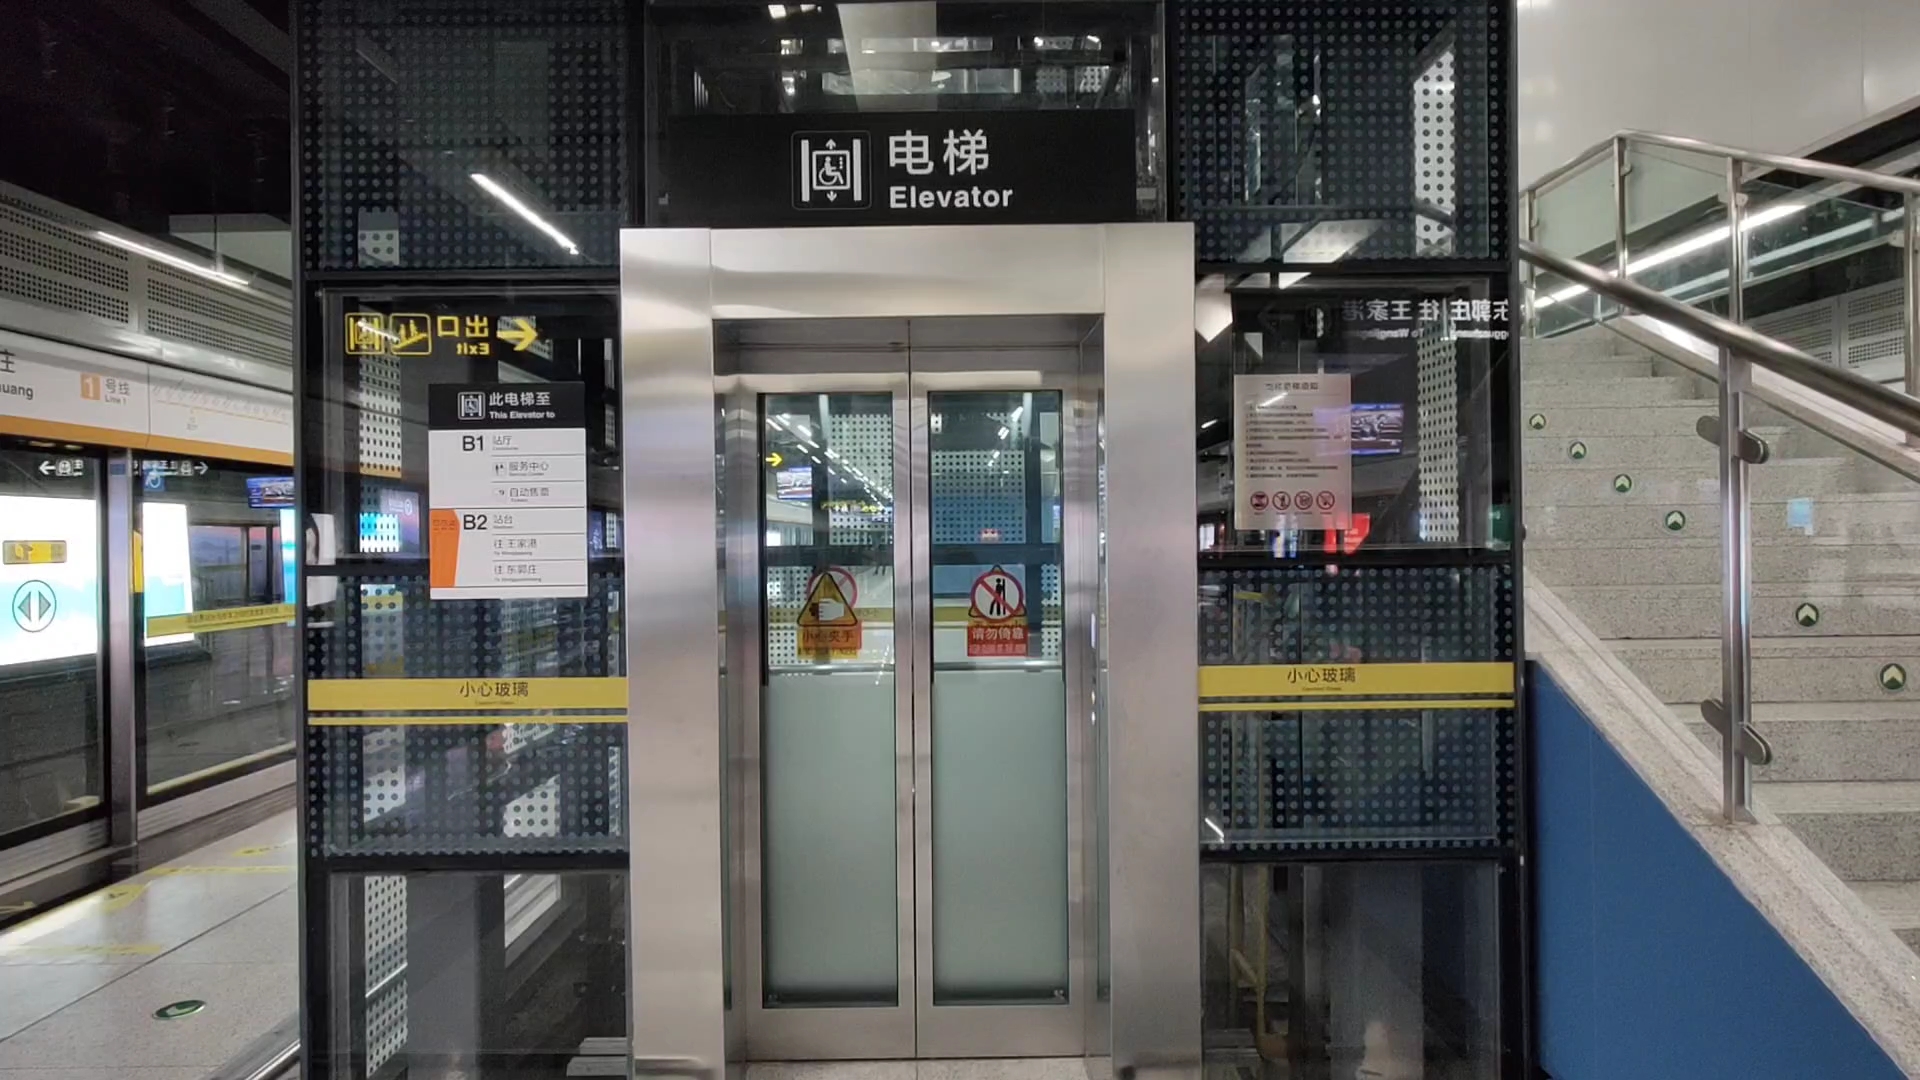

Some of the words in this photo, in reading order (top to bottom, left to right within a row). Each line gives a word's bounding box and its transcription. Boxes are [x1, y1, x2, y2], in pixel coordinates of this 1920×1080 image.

[888, 129, 990, 176] 电梯
[889, 186, 1013, 209] Elevator
[84, 376, 94, 398] 1
[105, 378, 130, 396] 号线
[488, 392, 551, 407] 此电梯至
[489, 411, 507, 420] This
[509, 411, 545, 419] Elevator
[546, 411, 556, 419] to
[462, 435, 484, 451] B1
[509, 461, 549, 472] 服务中心
[463, 514, 488, 530] B2
[972, 628, 1024, 641] 请勿倚靠
[1287, 667, 1356, 683] 小心玻璃
[459, 681, 529, 698] 小心玻璃
